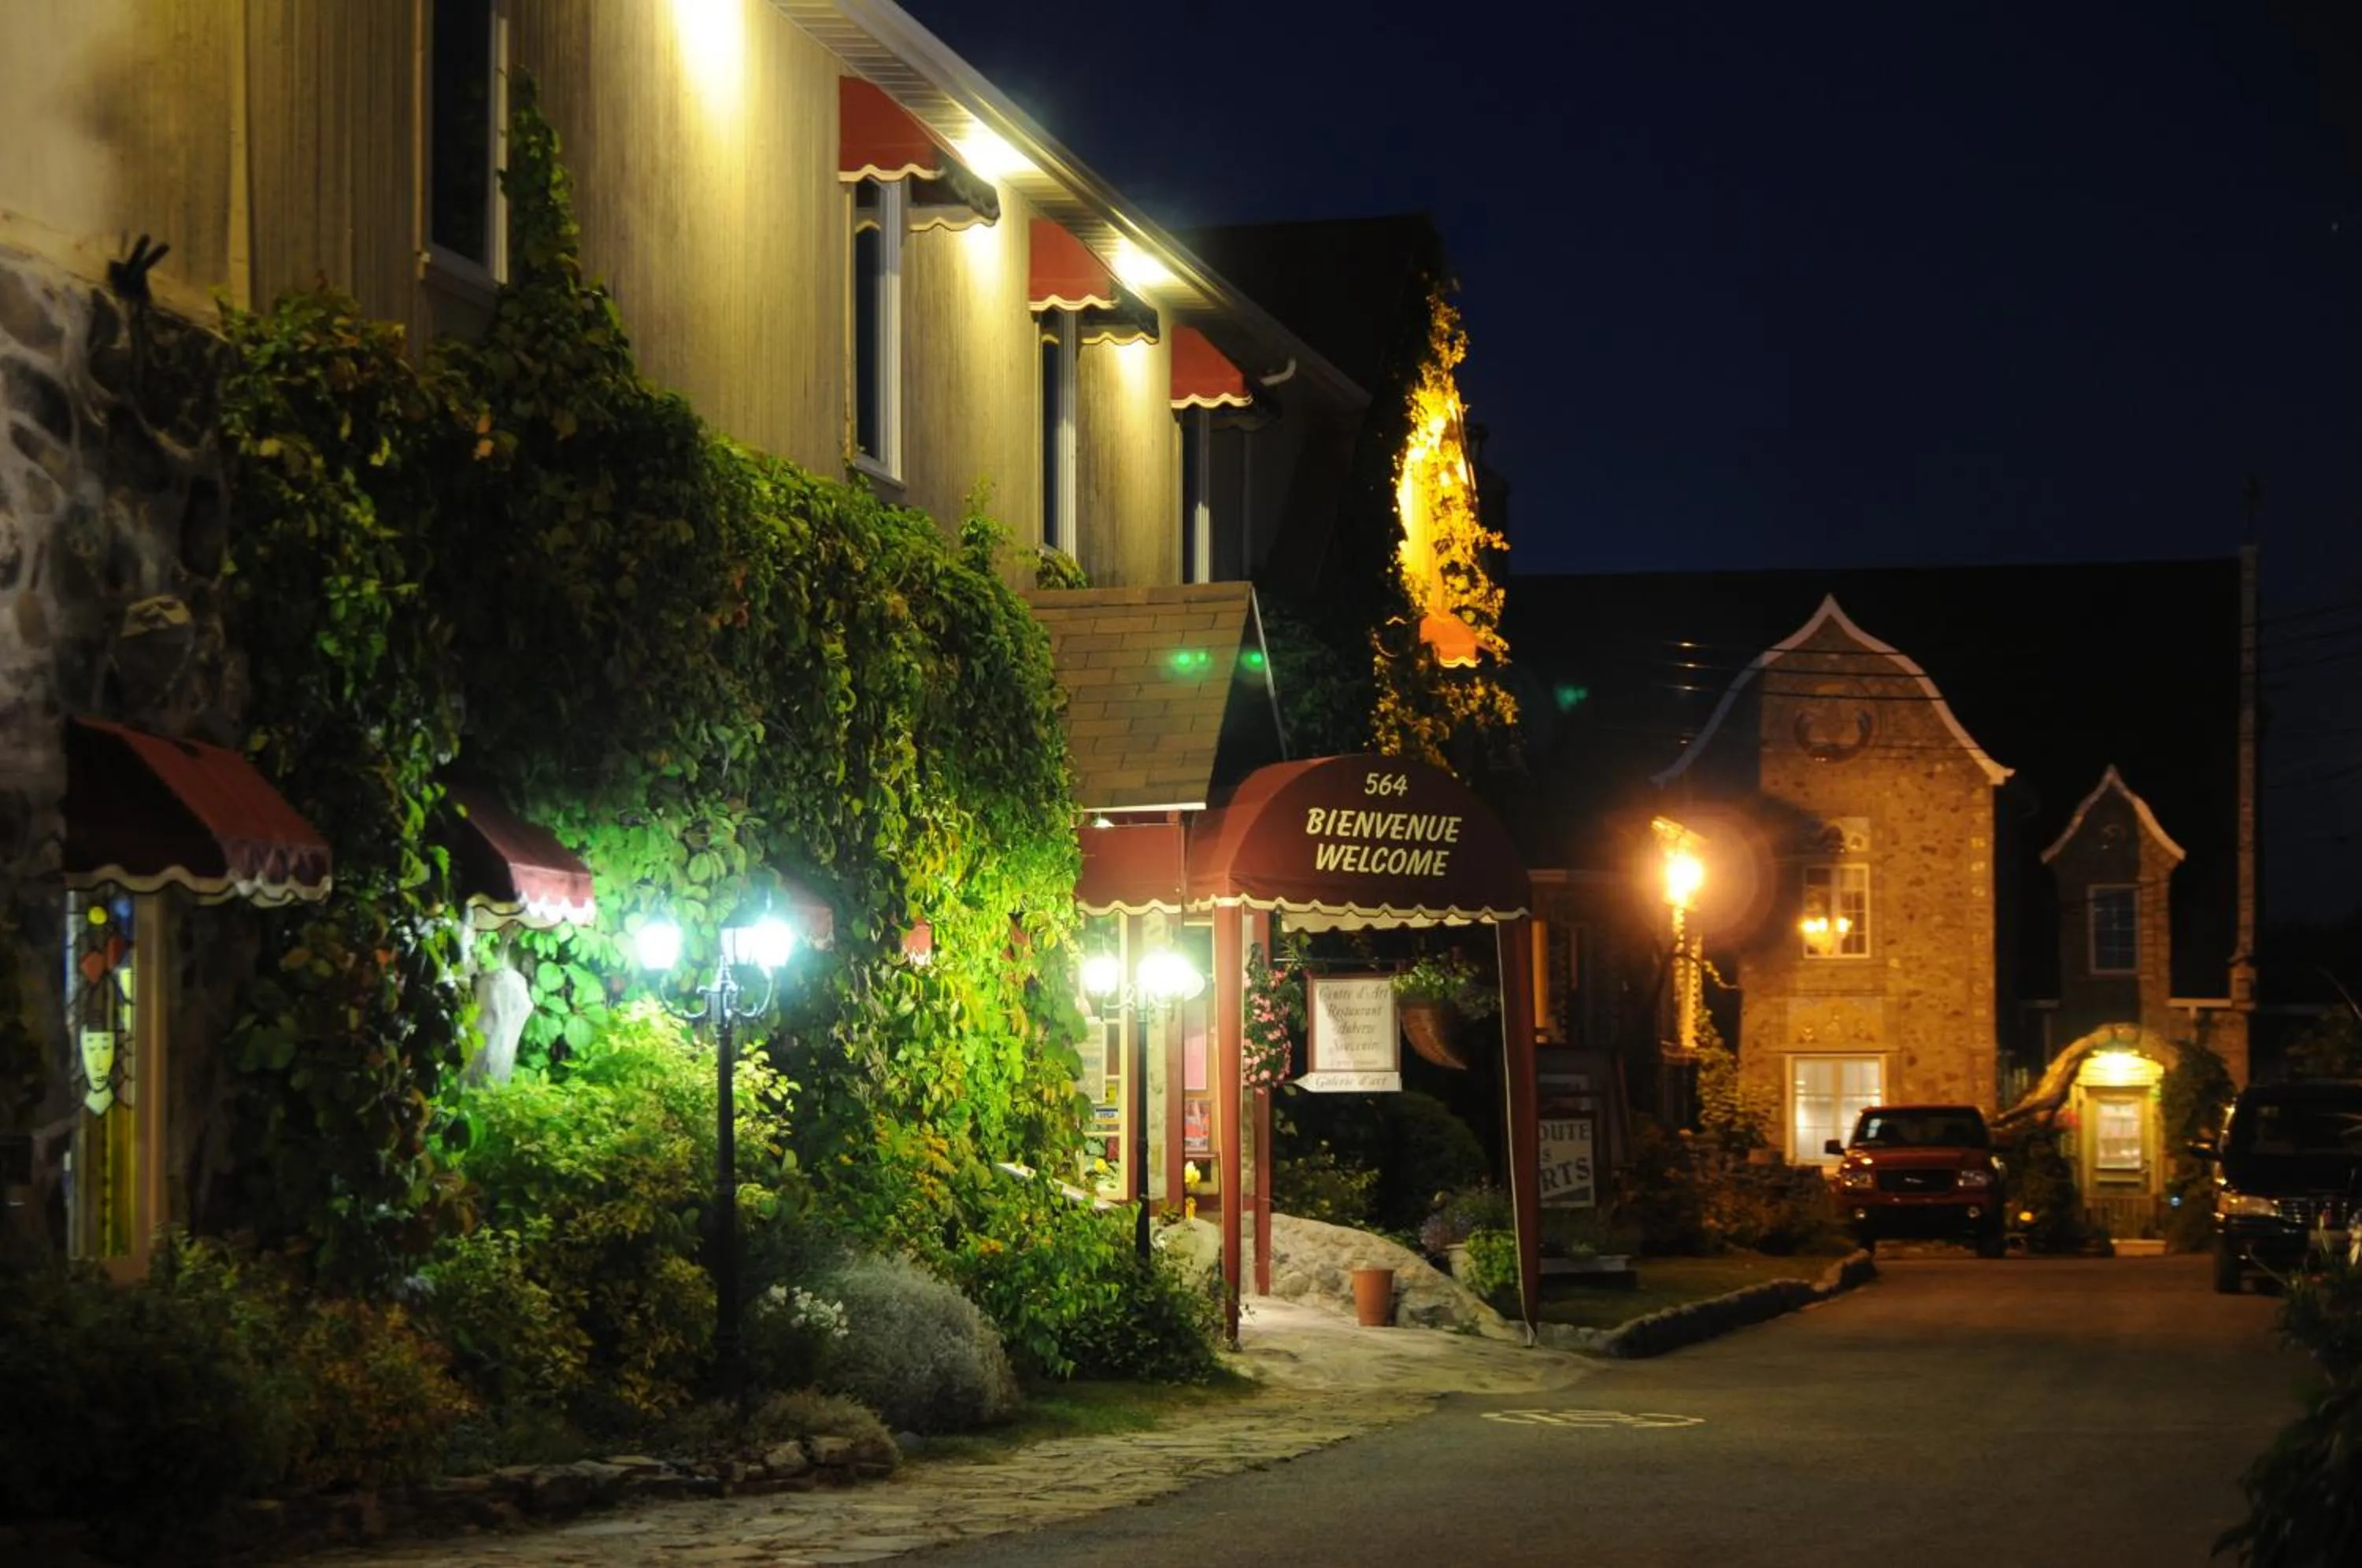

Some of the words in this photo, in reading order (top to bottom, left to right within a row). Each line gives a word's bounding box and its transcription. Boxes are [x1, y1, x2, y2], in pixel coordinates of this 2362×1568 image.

[1364, 772, 1409, 797] 564
[1305, 807, 1462, 843] BIENVENUE
[1315, 843, 1449, 877] WELCOME
[1327, 1003, 1382, 1022] Restaurant
[1539, 1122, 1590, 1141] OUTE
[1540, 1156, 1590, 1192] RTS
